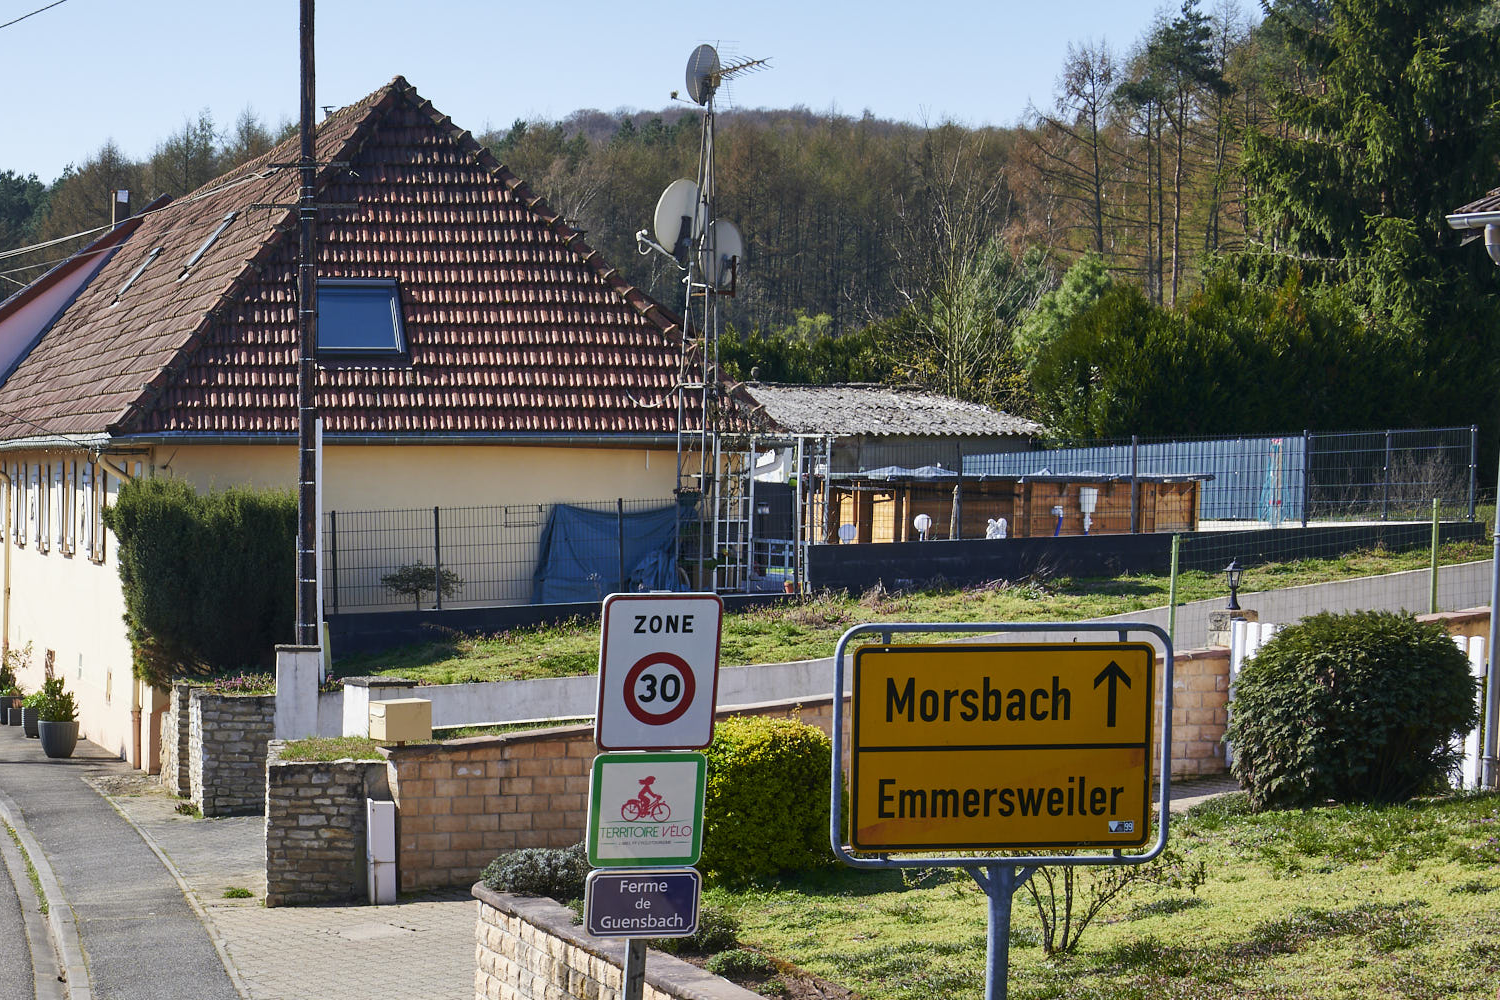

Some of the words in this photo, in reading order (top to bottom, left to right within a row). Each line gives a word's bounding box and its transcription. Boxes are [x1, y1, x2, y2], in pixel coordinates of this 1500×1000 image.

[633, 614, 695, 634] ZONE
[638, 673, 681, 703] 30
[886, 676, 1071, 723] Morsbach
[878, 776, 1125, 819] Emmersweiler
[600, 826, 659, 839] TERRITOIRE
[662, 824, 693, 838] VÉLO
[619, 880, 668, 894] Ferme
[635, 898, 651, 910] de
[600, 913, 684, 929] Guensbach
